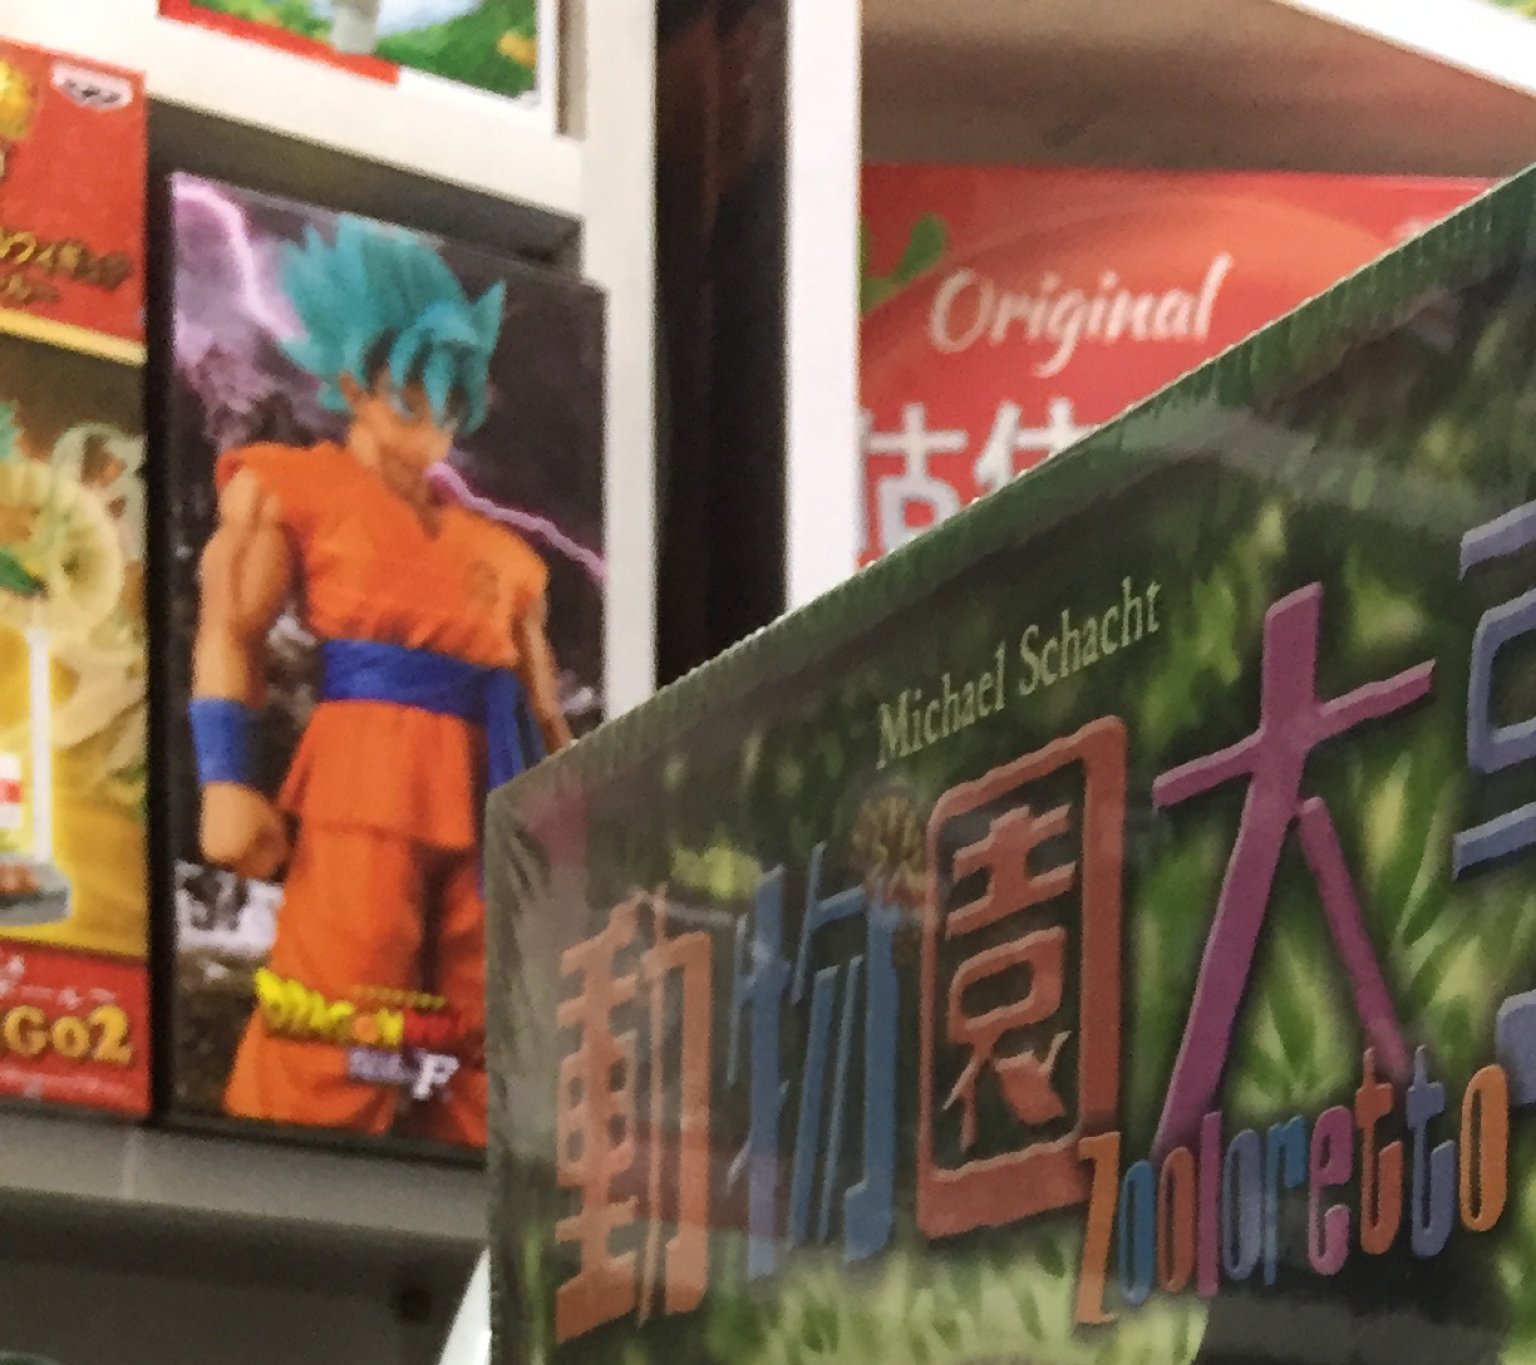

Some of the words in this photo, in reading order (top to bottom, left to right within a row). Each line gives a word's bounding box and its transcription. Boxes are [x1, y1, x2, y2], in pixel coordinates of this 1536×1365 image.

[928, 251, 1234, 379] Original
[876, 640, 1006, 770] Michael
[1018, 575, 1162, 697] Schacht
[1074, 1044, 1509, 1326] Zooloretto
